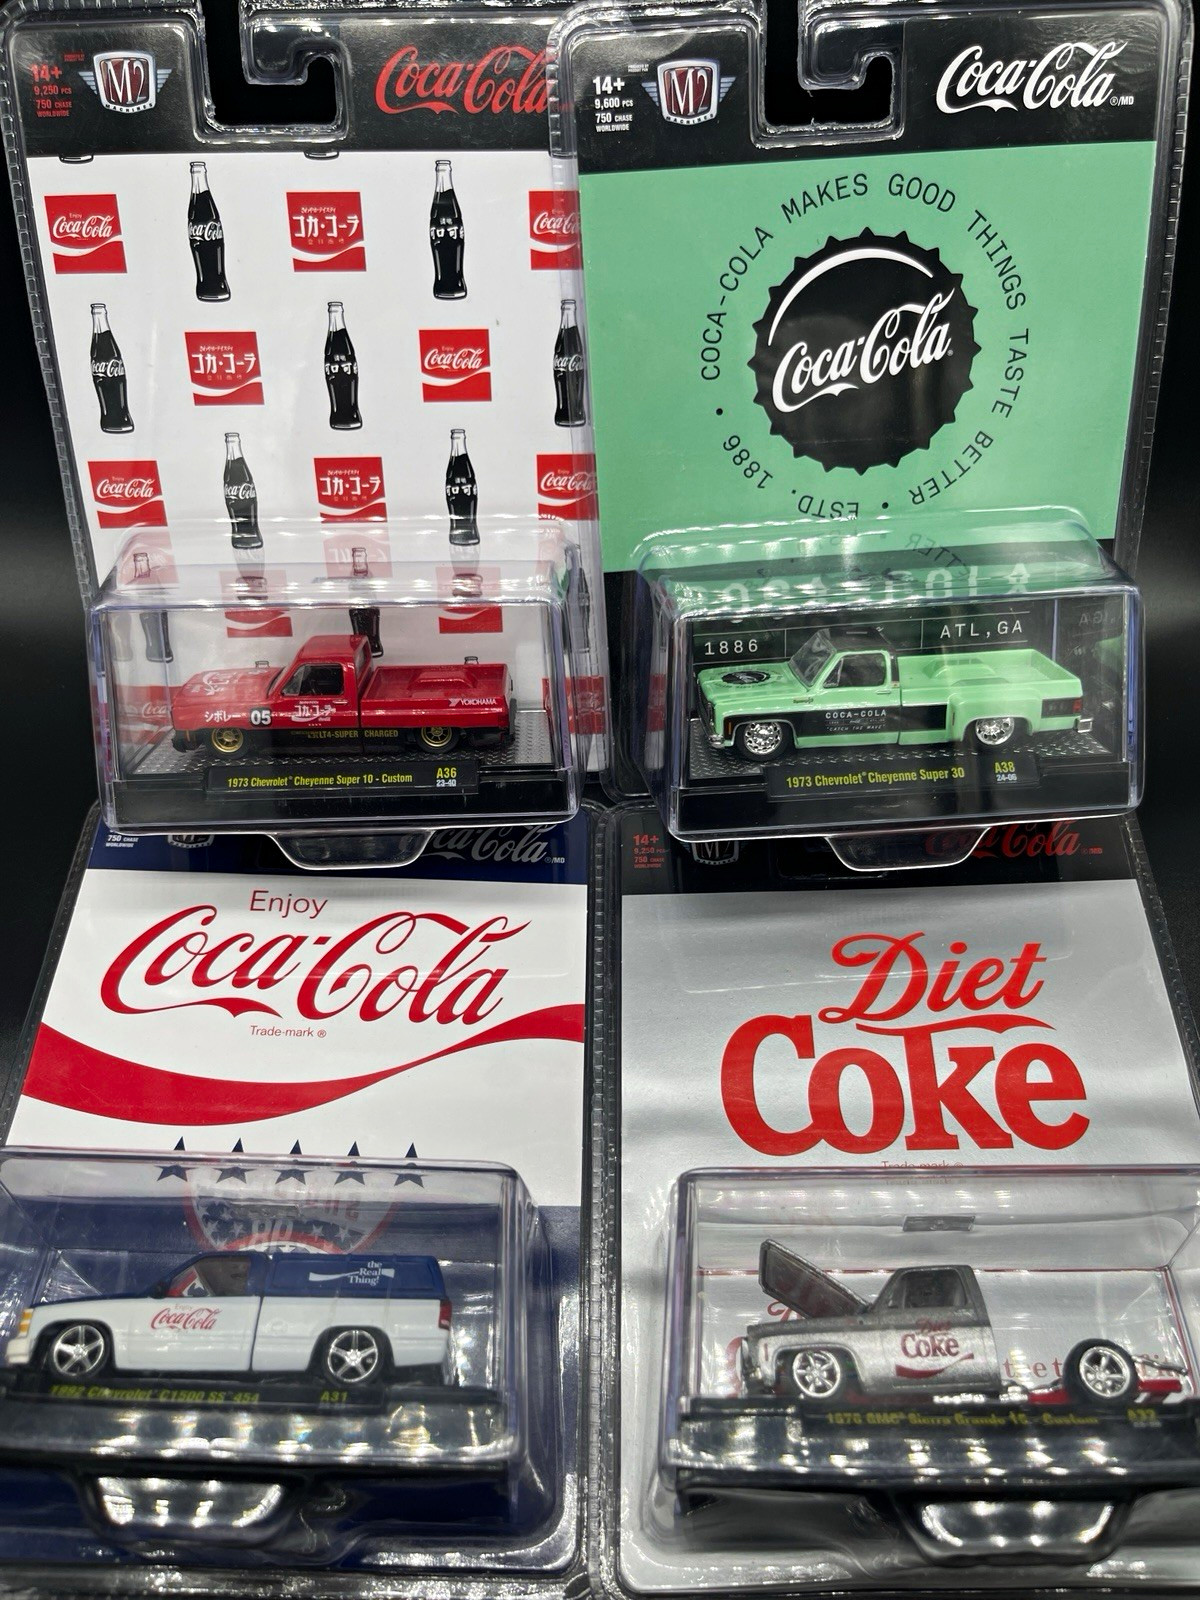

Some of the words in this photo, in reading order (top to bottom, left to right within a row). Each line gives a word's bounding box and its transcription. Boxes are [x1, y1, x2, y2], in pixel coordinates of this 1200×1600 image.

[31, 63, 62, 82] 14+
[103, 59, 147, 105] M2
[936, 41, 1128, 114] Coca-Cola
[34, 85, 58, 96] 9,250
[592, 75, 625, 96] 14+
[668, 67, 709, 116] M2
[36, 99, 52, 109] 750
[37, 109, 70, 117] WORLDWIDE
[594, 98, 620, 109] 9,600
[595, 112, 612, 123] 750
[614, 114, 633, 122] CHASE
[596, 124, 630, 132] WORLDWIDE
[780, 173, 869, 224] MAKES
[888, 174, 957, 213] GOOD
[53, 214, 114, 239] Coca-Cola
[292, 215, 360, 238] コカ・コーラ
[965, 209, 1027, 312] THINGS
[701, 226, 773, 380] COCA-COLA
[424, 348, 485, 371] Coca-Cola
[773, 287, 955, 413] Coca-Cola
[192, 353, 256, 375] コカ・コーラ
[991, 327, 1030, 419] TASTE
[723, 435, 773, 489] 1886
[909, 430, 995, 506] BETTER
[97, 478, 155, 499] Coca-Cola
[320, 476, 381, 497] コカ・コーラ
[704, 638, 759, 656] 1886
[461, 698, 497, 706] YOKOHAMA
[204, 710, 242, 722] シボレー
[250, 709, 272, 725] 05
[825, 708, 887, 720] COCA-COLA
[364, 729, 399, 738] CHARGED
[436, 767, 457, 779] A36
[786, 775, 812, 788] 1973
[867, 769, 917, 785] Cheyenne
[919, 767, 949, 782] Super
[951, 767, 965, 779] 30
[994, 761, 1016, 774] A38
[228, 777, 249, 788] 1973
[294, 775, 334, 788] Cheyenne
[336, 774, 360, 787] Super
[363, 774, 374, 784] 10
[382, 772, 412, 784] Custom
[633, 834, 659, 846] 14+
[249, 889, 329, 919] Enjoy
[100, 904, 532, 1025] Coca-Cola
[818, 931, 1048, 1025] Diet
[250, 1025, 314, 1038] Trade-mark
[720, 1013, 1091, 1157] Coke
[359, 1268, 383, 1276] Real
[367, 1259, 383, 1270] the
[350, 1275, 380, 1286] Thing!
[150, 1307, 223, 1331] Coca-Cola
[900, 1333, 960, 1360] Coke
